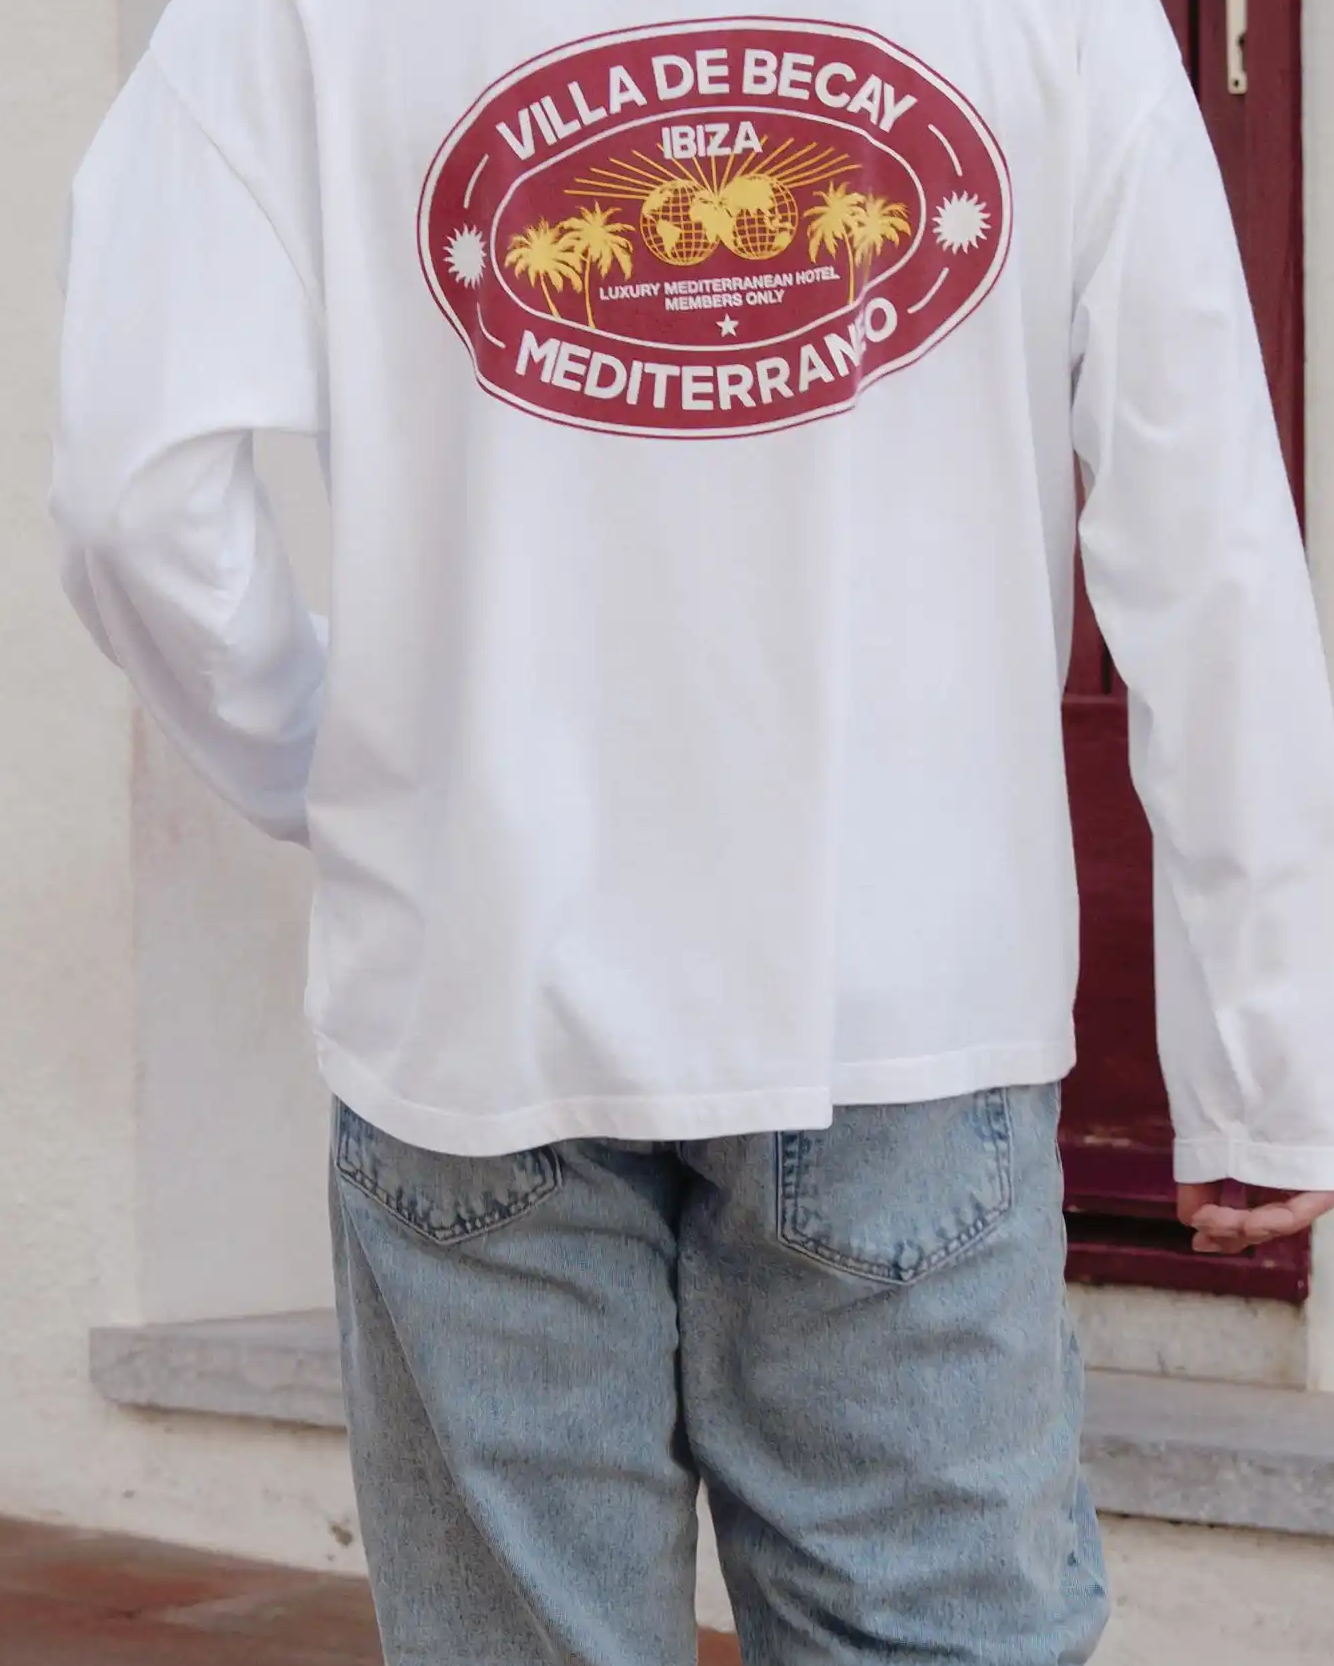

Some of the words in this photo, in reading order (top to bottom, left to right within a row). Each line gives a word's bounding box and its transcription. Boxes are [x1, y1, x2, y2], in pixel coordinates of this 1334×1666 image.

[496, 65, 647, 161] VILLA
[651, 48, 731, 101] DE
[742, 48, 918, 133] BECAY
[662, 120, 763, 160] IBIZA
[599, 282, 661, 301] LUXURY
[664, 273, 794, 294] MEDITERRANEAN
[795, 265, 841, 284] HOTEL
[664, 293, 743, 311] MEMBERS
[745, 289, 786, 306] ONLY
